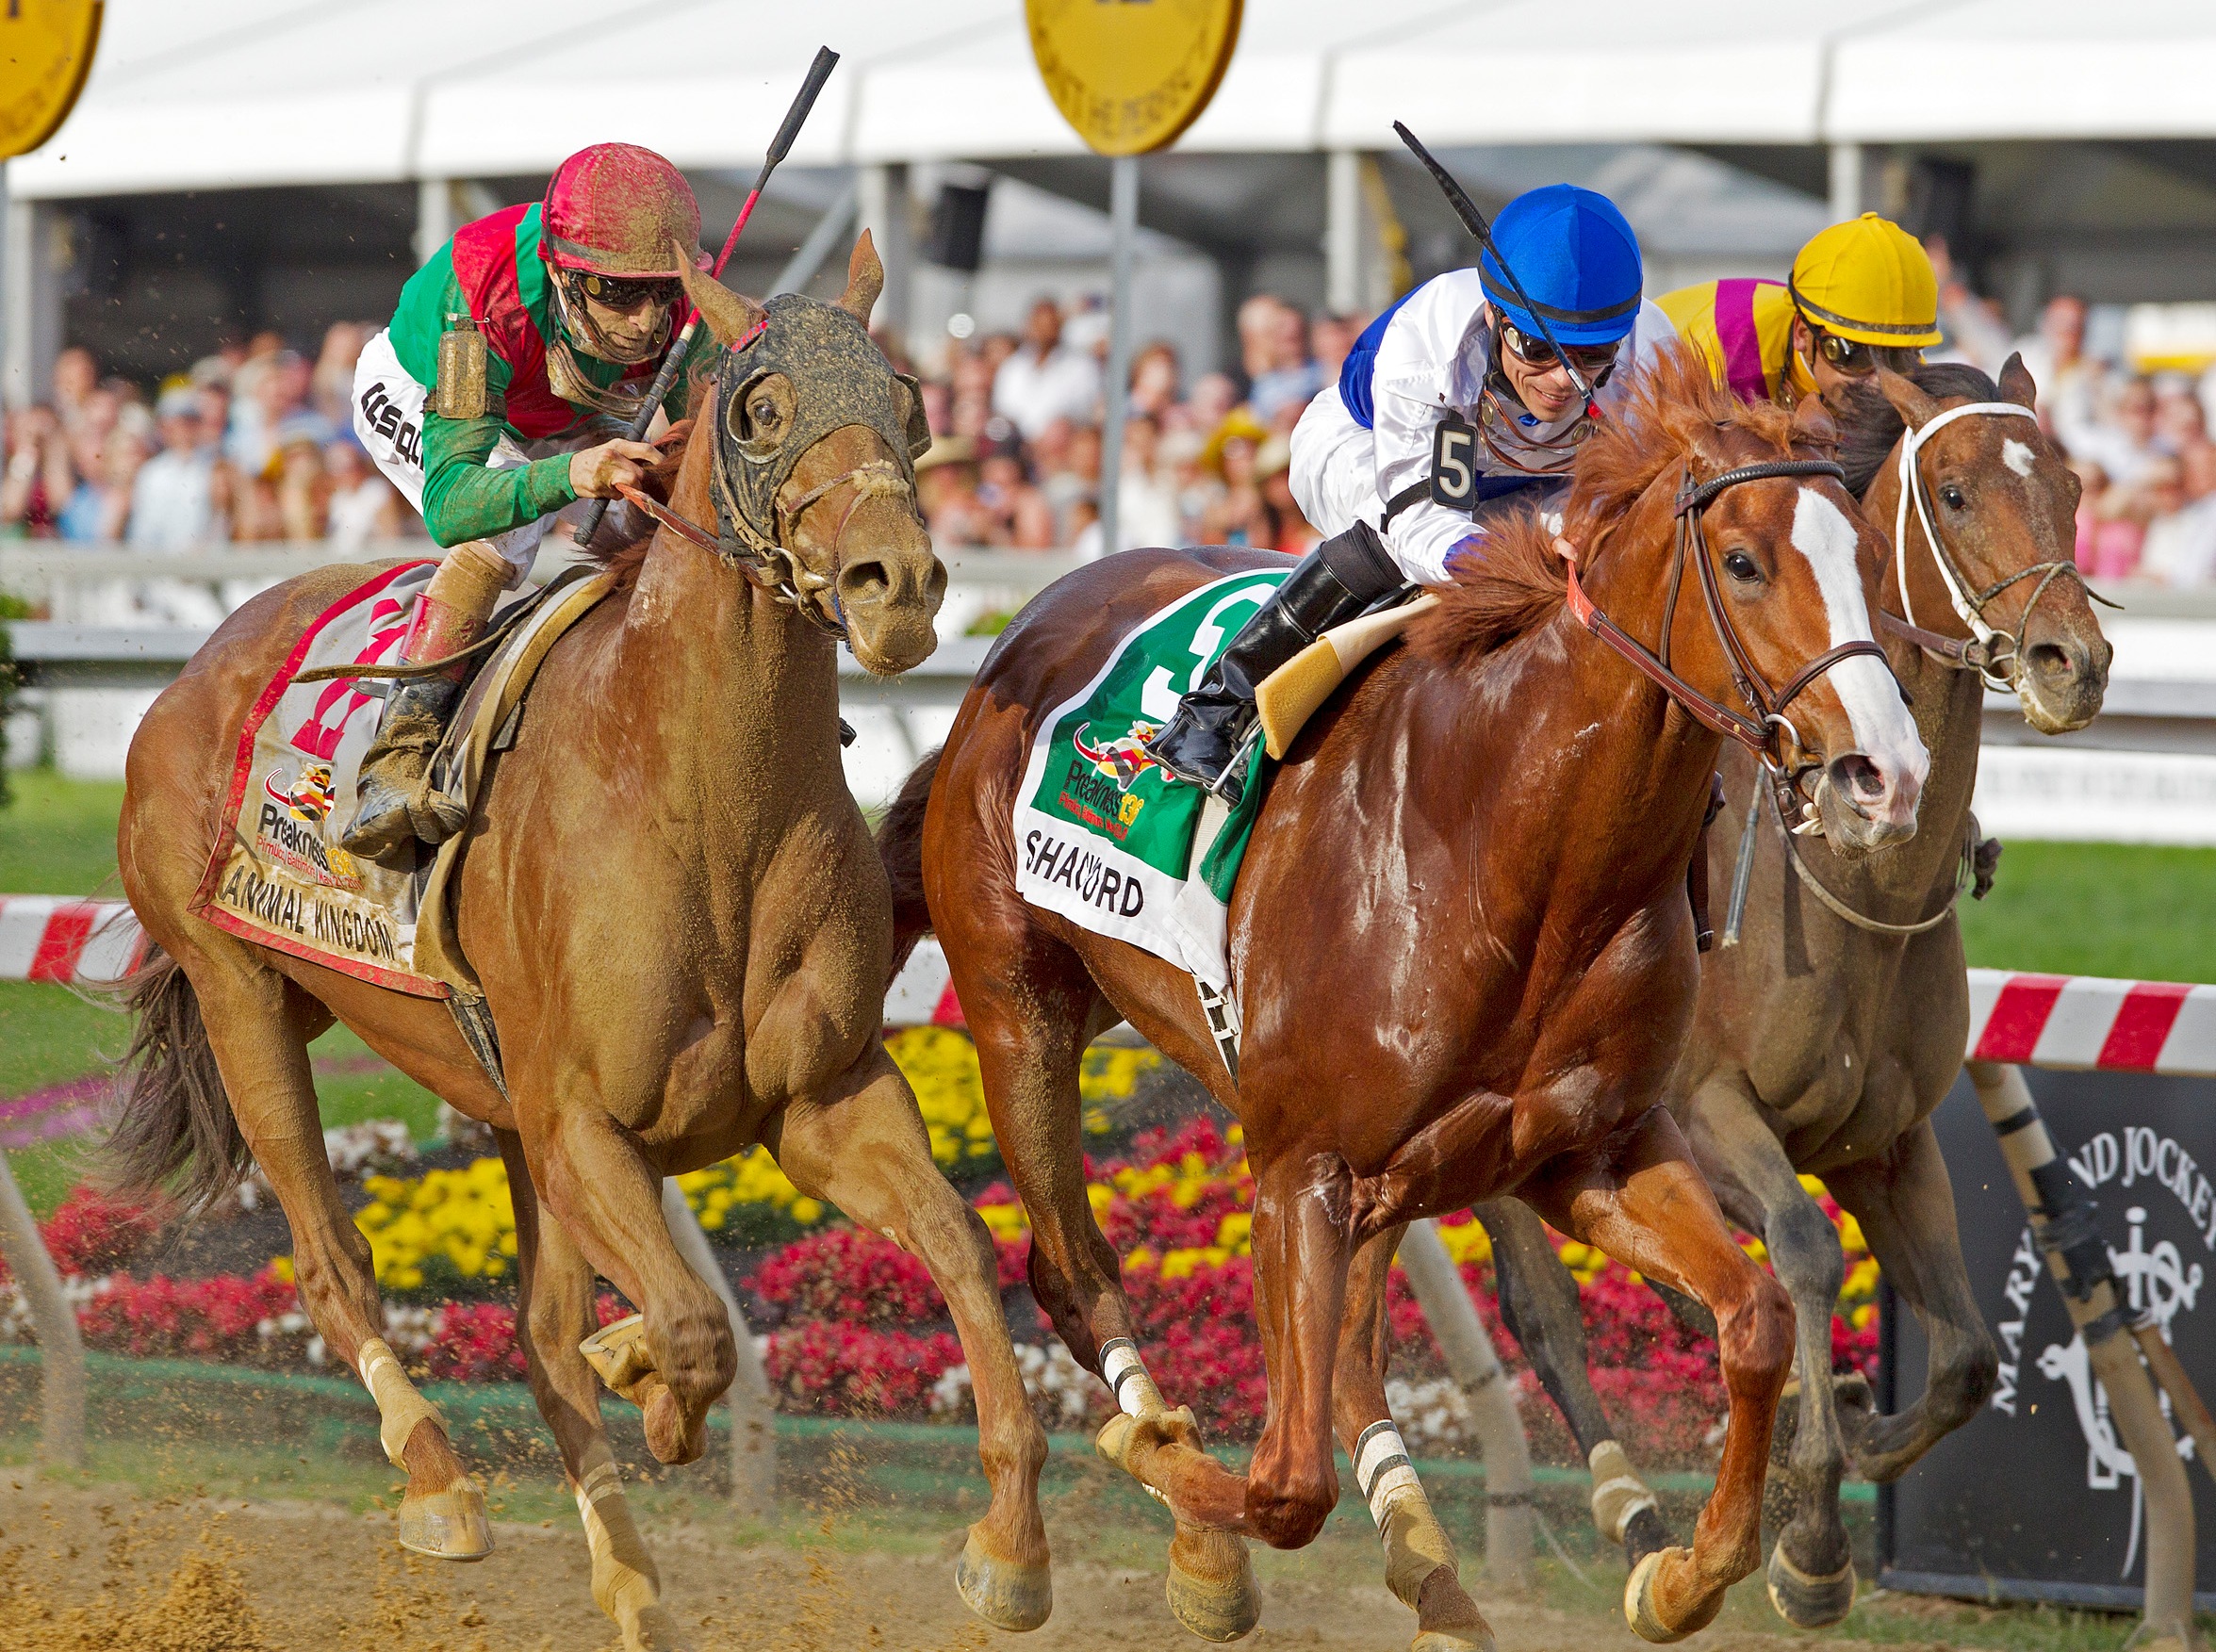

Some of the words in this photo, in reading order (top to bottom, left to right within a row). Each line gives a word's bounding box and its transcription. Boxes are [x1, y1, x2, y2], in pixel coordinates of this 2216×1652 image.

[1438, 430, 1471, 499] 5
[257, 803, 330, 872] Preakness
[1118, 793, 1144, 826] 136
[221, 865, 304, 934] ANIMAL
[315, 899, 395, 961] KINGDOM
